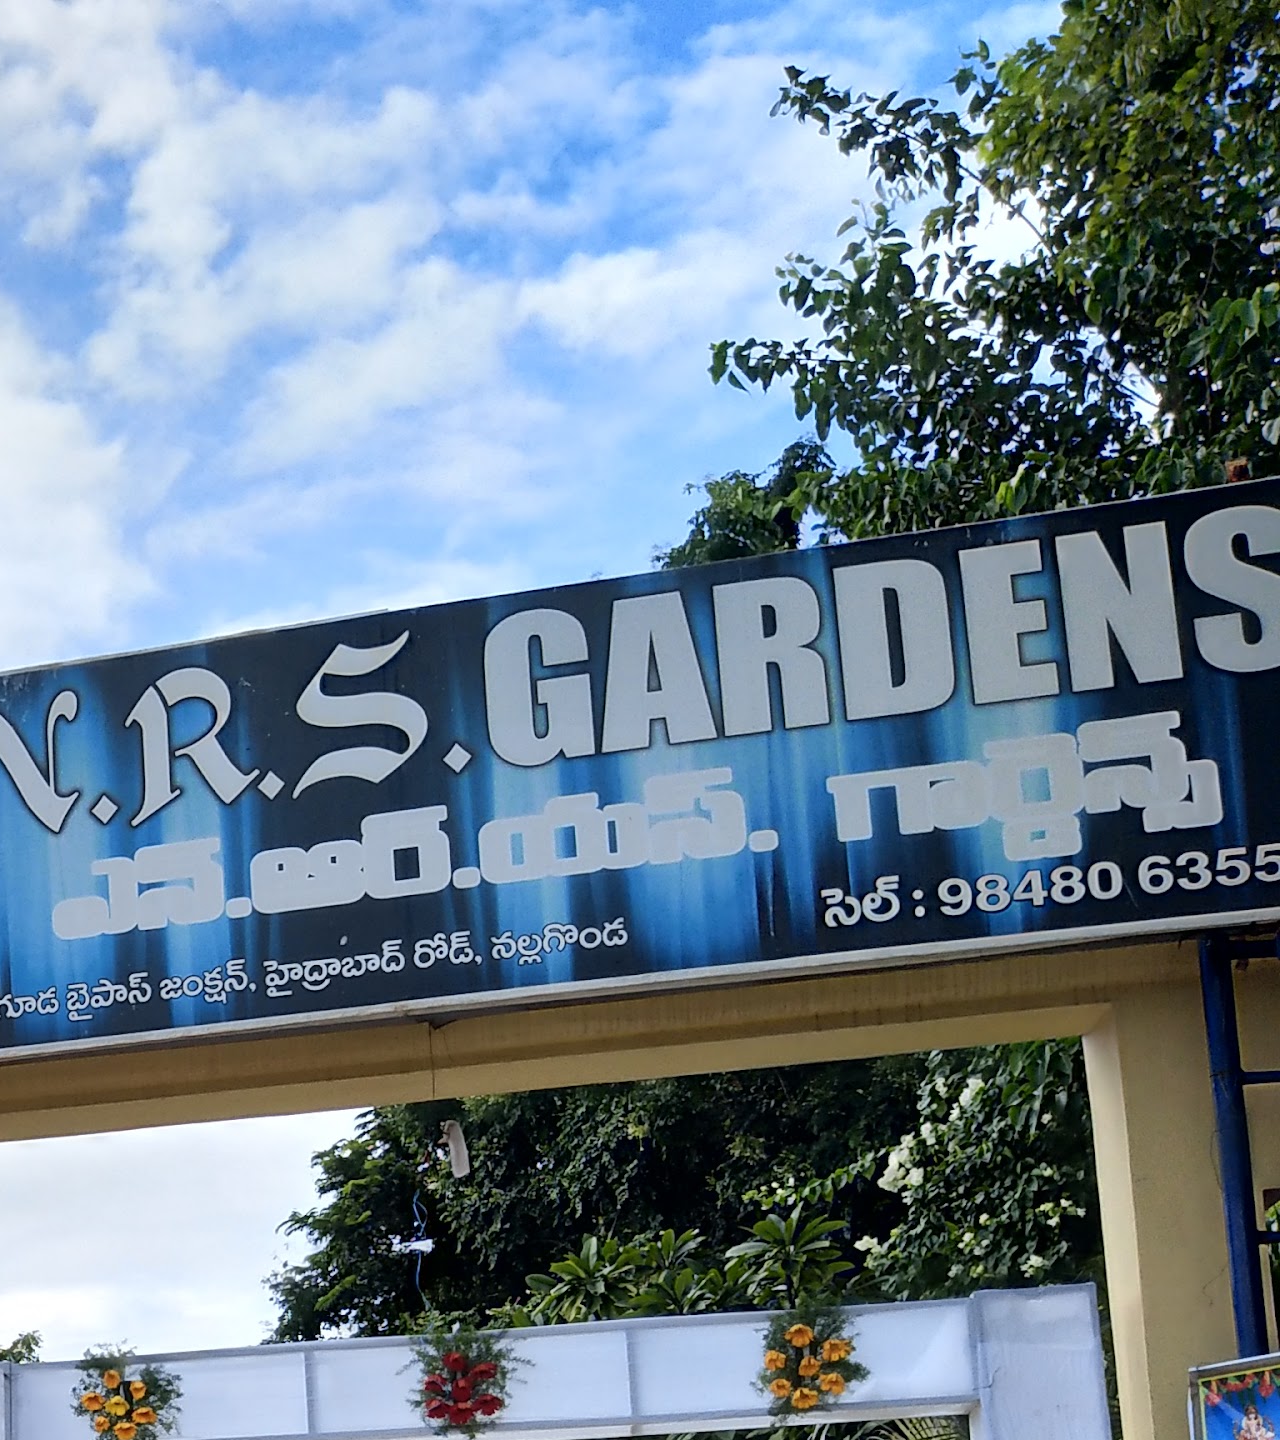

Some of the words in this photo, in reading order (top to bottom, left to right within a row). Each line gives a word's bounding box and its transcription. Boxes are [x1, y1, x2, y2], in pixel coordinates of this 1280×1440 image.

[483, 504, 1280, 767] GARDENS
[936, 861, 1124, 916] 98480
[1138, 842, 1280, 896] 6355
[66, 972, 153, 1021] బైపాస్
[490, 917, 629, 965] నల్లగొండ
